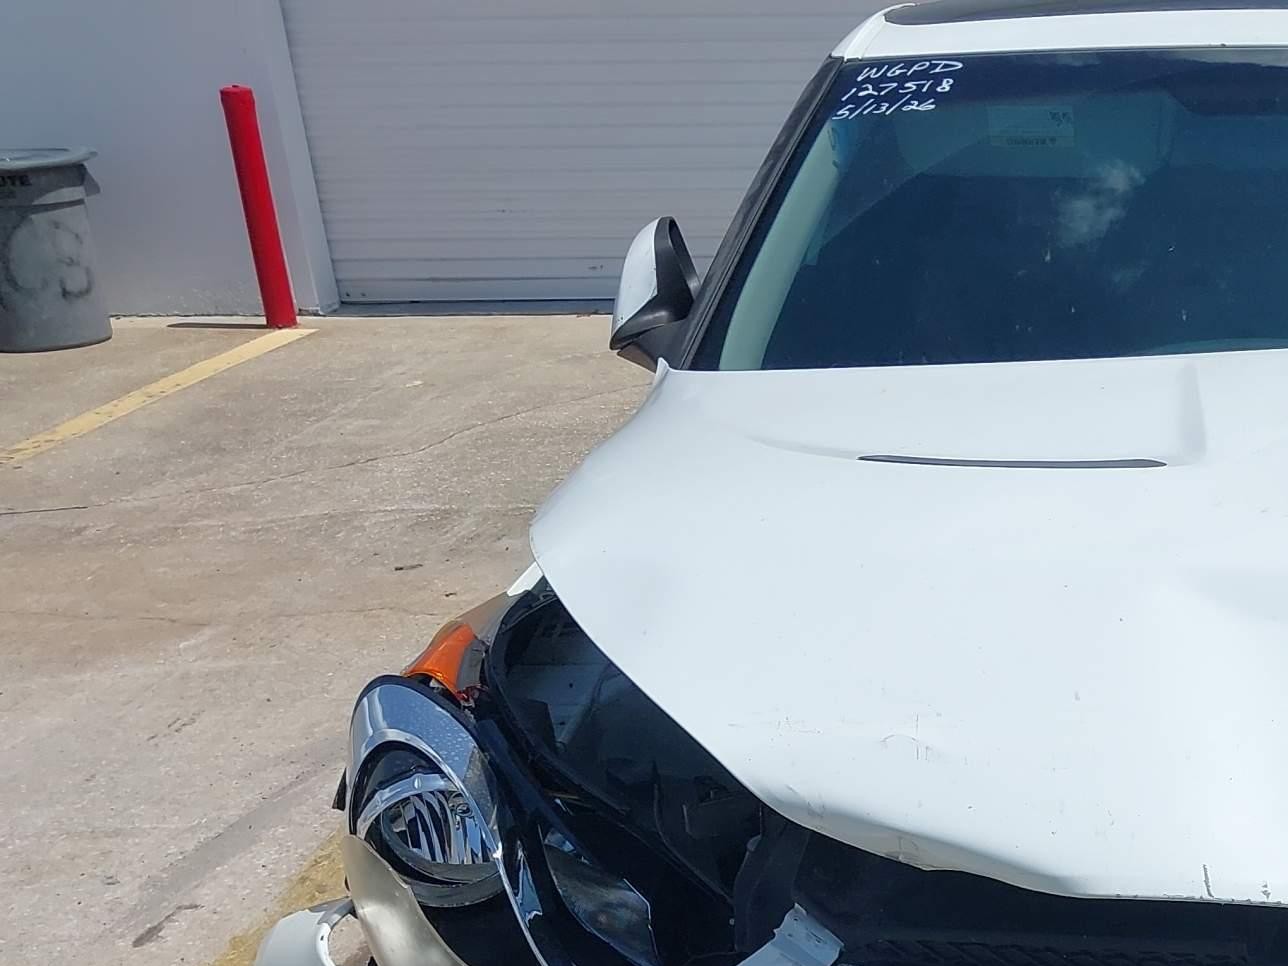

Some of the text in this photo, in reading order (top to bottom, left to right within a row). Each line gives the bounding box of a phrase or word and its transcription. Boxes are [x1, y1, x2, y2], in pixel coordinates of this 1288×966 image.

[856, 60, 964, 82] WGPD
[841, 78, 954, 102] 127518
[831, 94, 936, 120] 5/13/26
